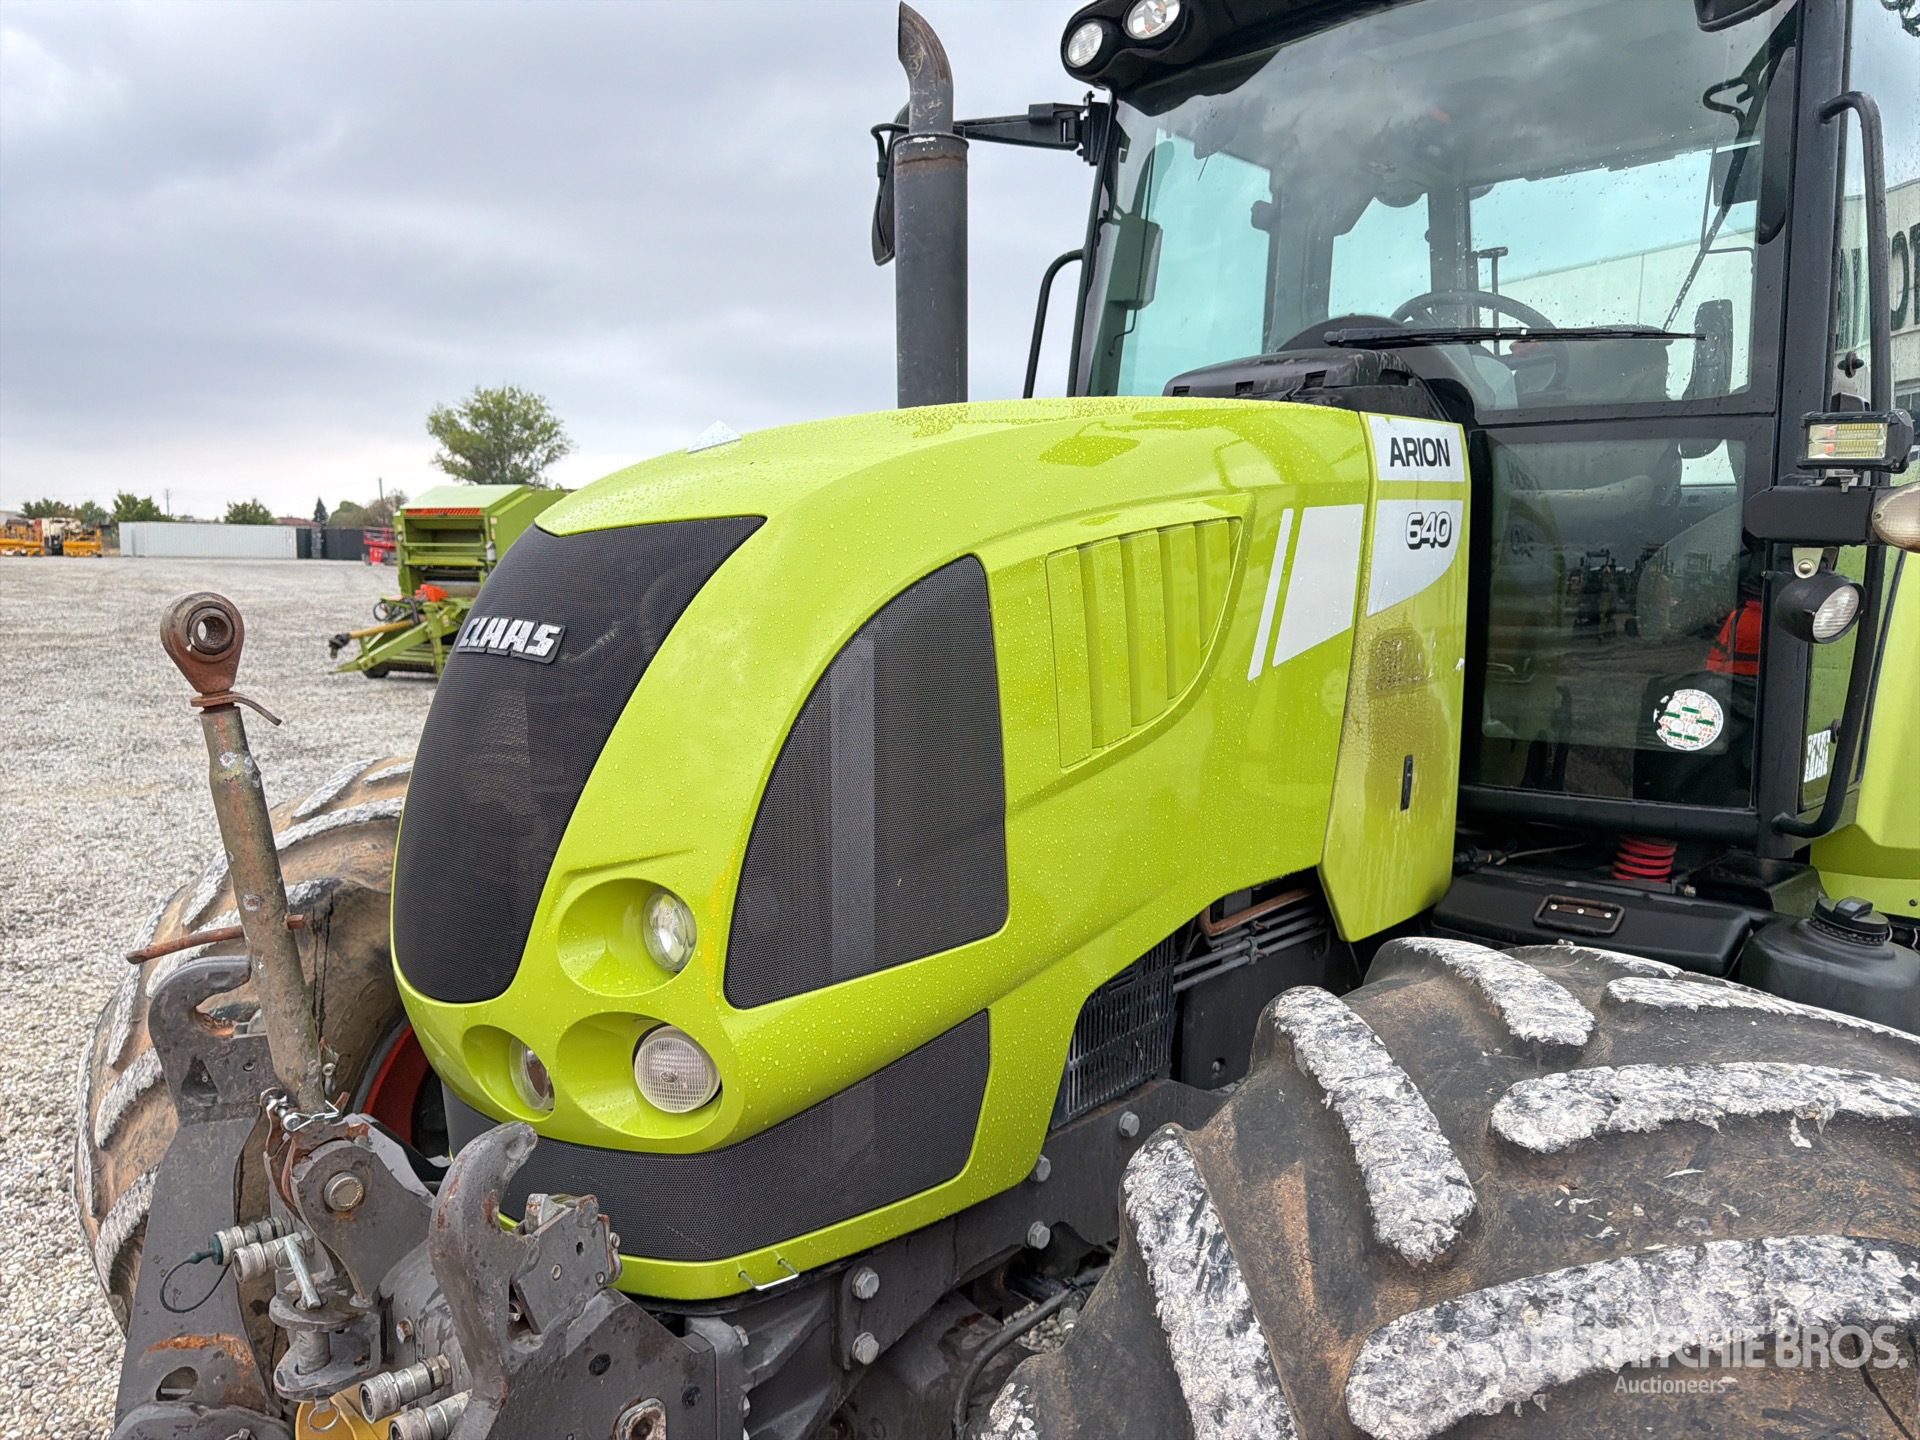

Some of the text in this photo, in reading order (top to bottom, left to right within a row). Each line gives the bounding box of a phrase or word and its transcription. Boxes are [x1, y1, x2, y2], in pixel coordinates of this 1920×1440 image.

[1389, 437, 1450, 467] ARION
[1405, 511, 1452, 550] 640
[457, 617, 562, 657] CLAAS
